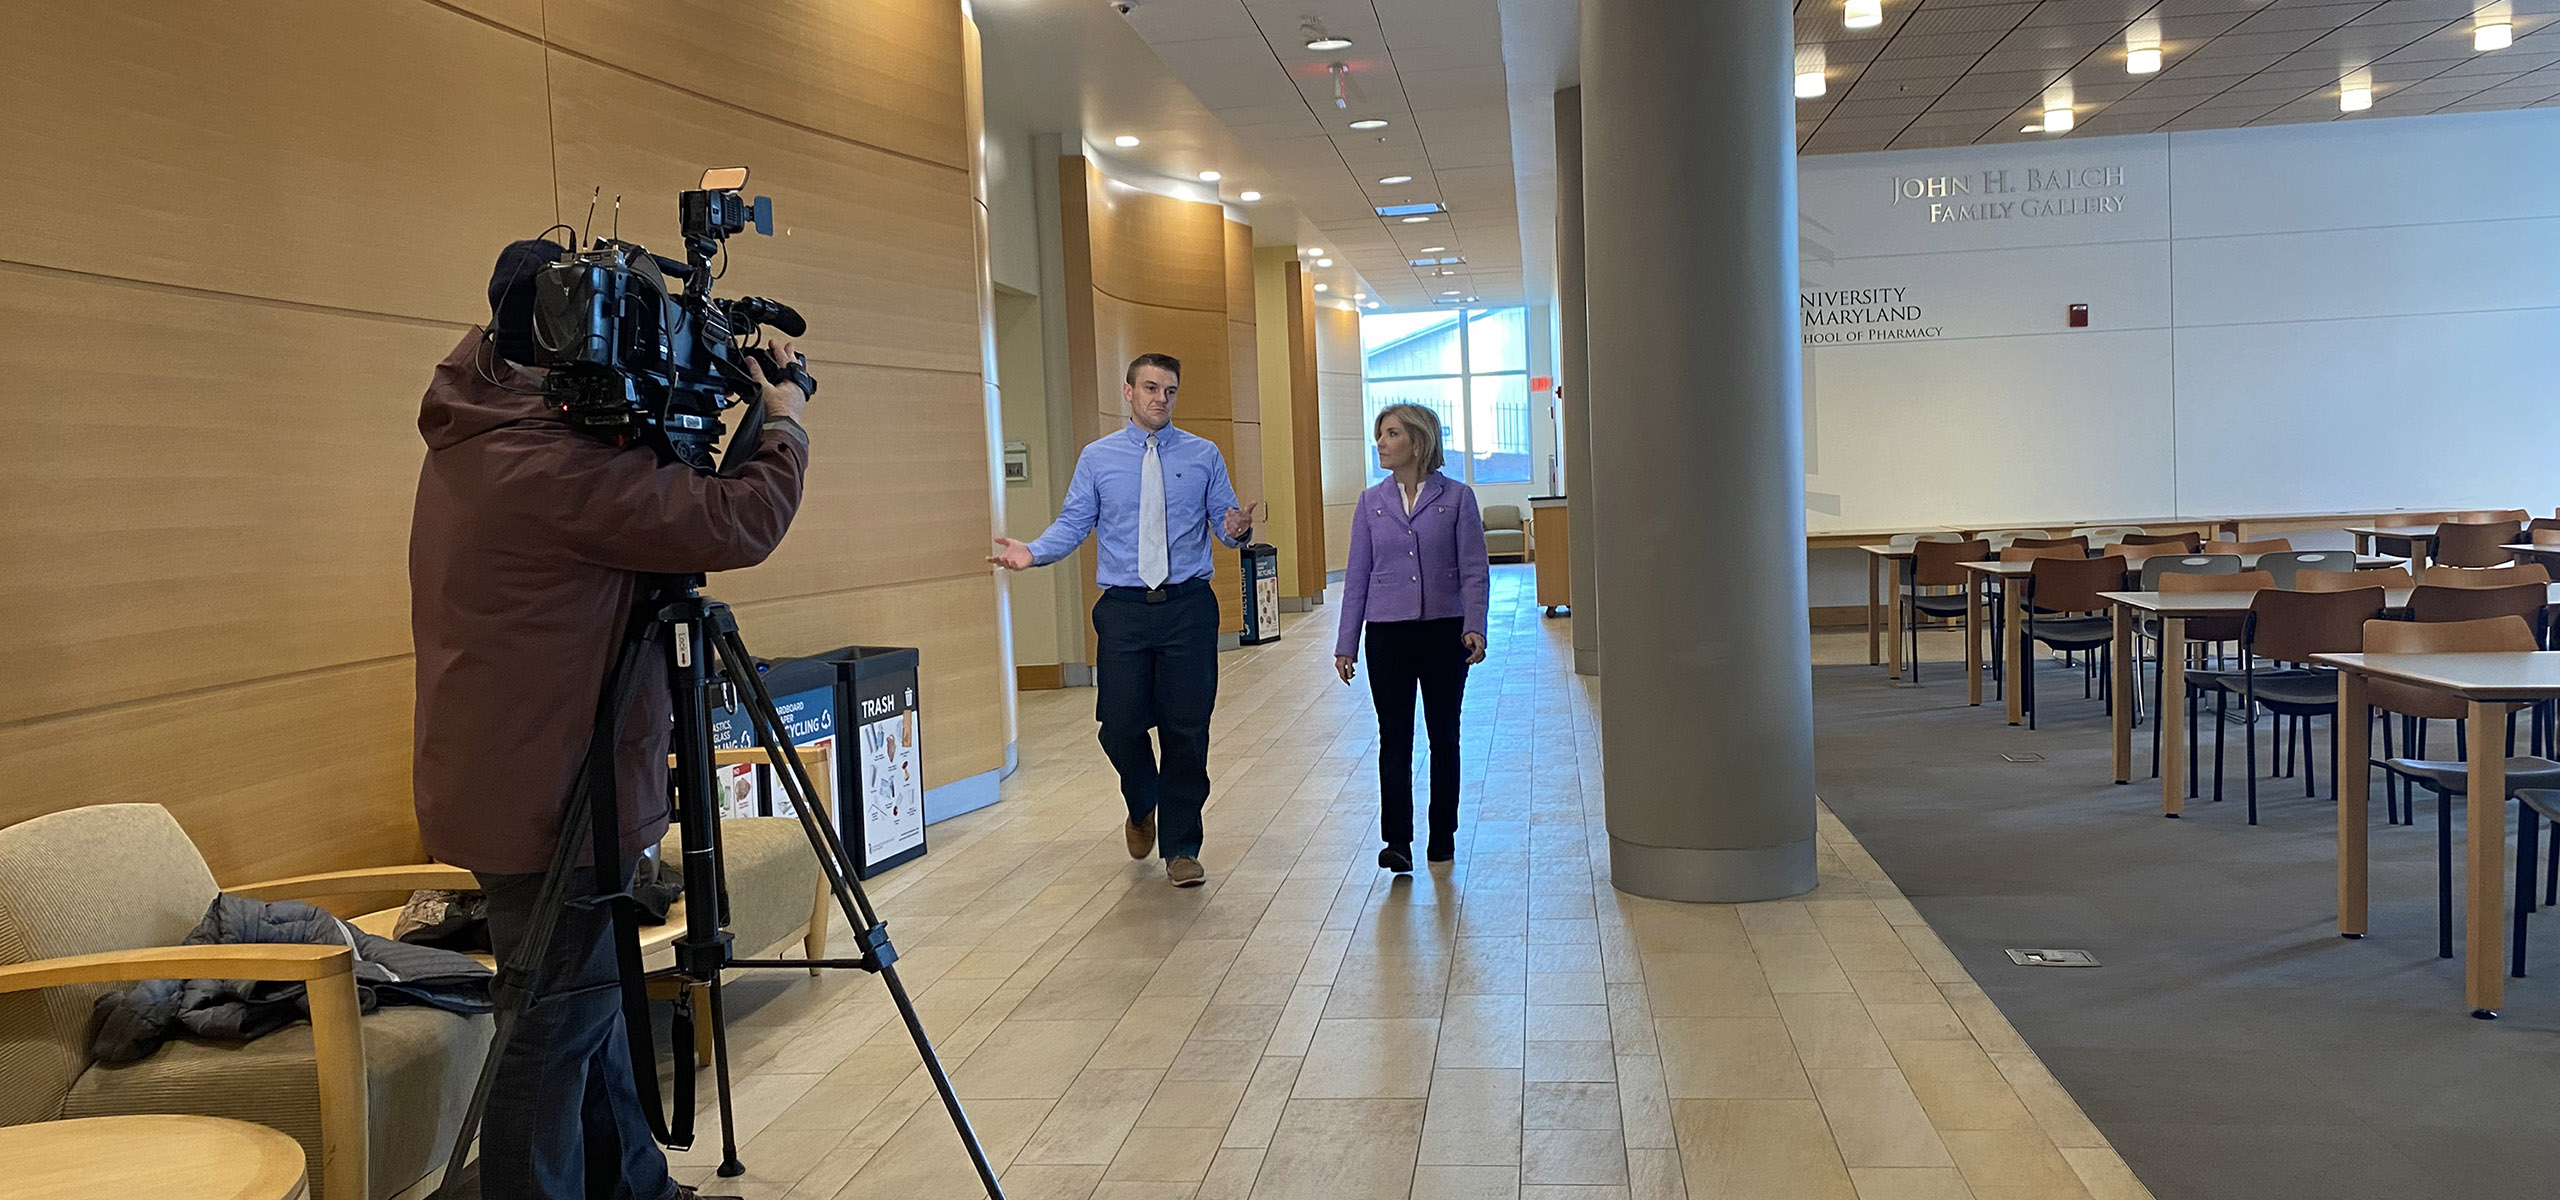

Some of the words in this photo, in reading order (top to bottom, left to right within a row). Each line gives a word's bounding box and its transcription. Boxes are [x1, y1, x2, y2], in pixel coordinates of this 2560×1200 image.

[1892, 175, 1971, 206] JOHN
[1983, 170, 2016, 195] H.
[2028, 166, 2124, 192] BALCH
[1929, 201, 2016, 223] FAMILY
[2021, 195, 2126, 217] GALLERY
[1800, 287, 1907, 308] NIVERSITY
[1805, 305, 1922, 326] MARYLAND
[1803, 332, 1842, 344] HOOL
[1846, 331, 1863, 341] OF
[1869, 327, 1944, 340] PHARMACY
[776, 701, 805, 715] ARDBOARD
[861, 694, 895, 719] TRASH
[780, 713, 795, 724] APER
